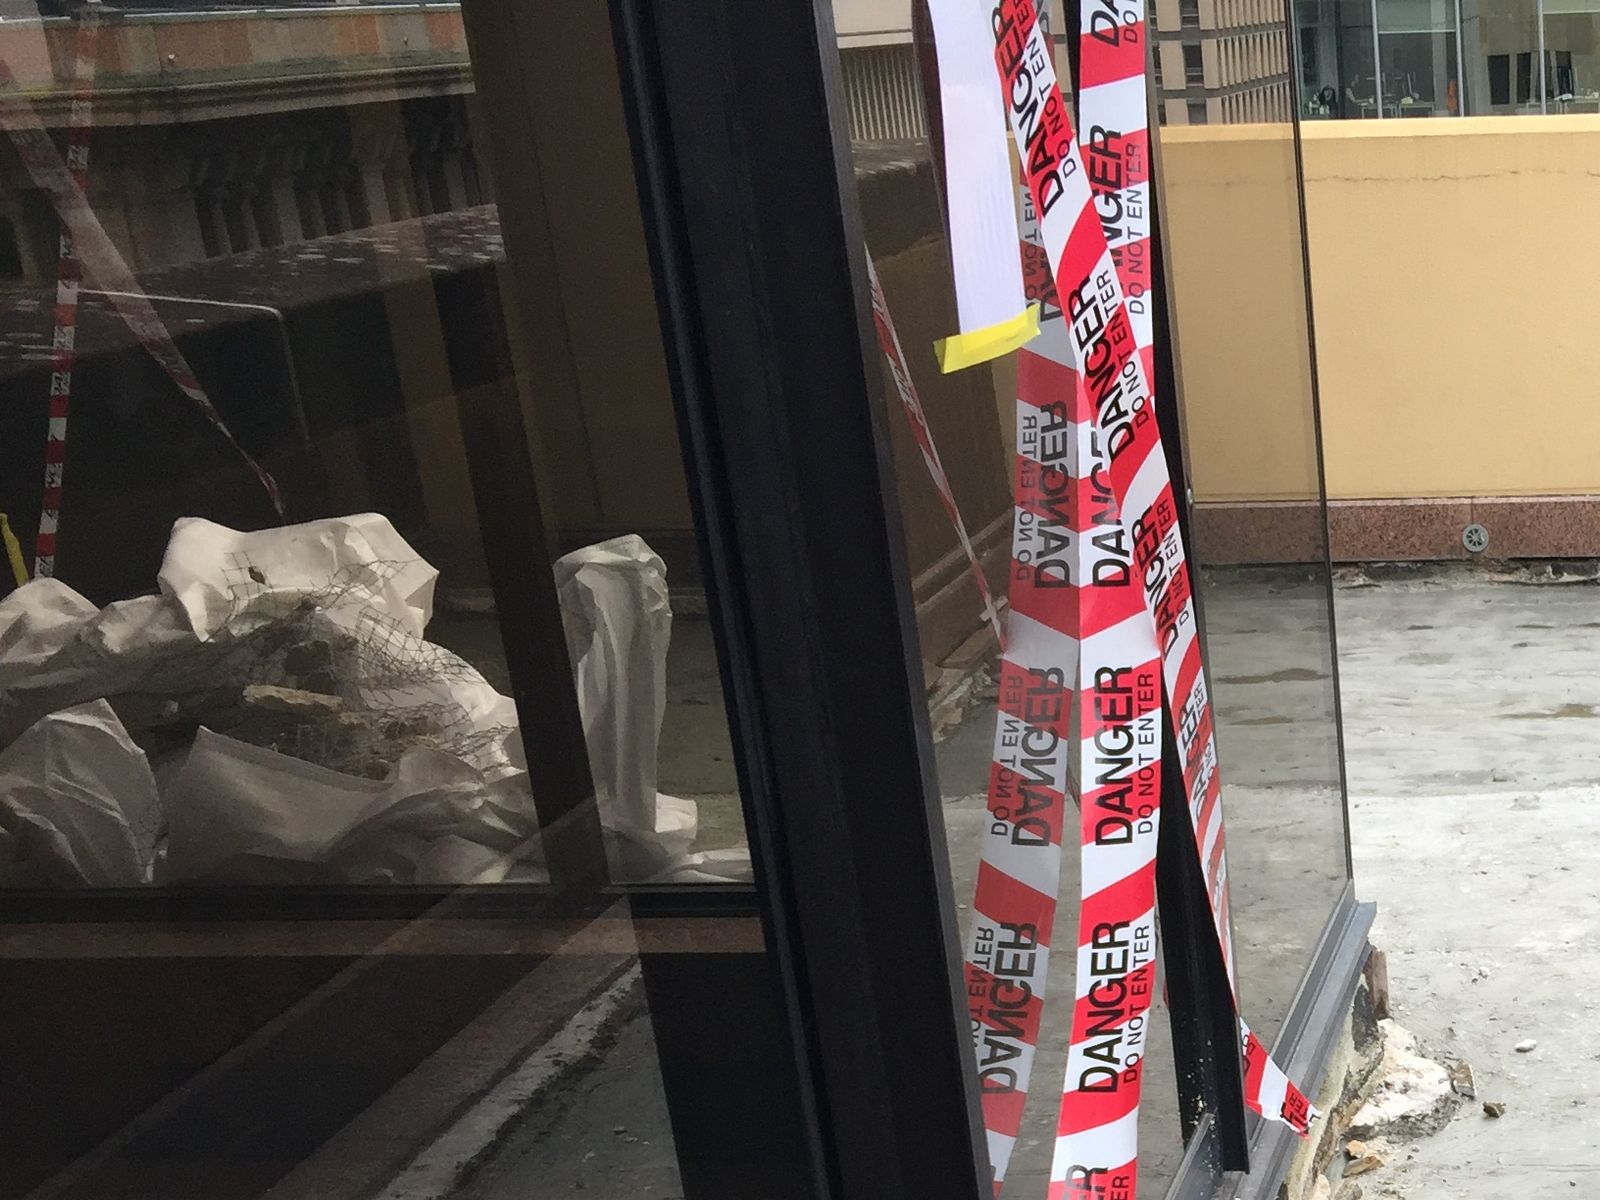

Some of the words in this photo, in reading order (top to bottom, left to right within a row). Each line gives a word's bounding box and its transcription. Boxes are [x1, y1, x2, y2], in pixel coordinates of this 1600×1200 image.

[991, 0, 1064, 218] DANGER
[1038, 83, 1064, 136] NOT
[1057, 139, 1077, 179] DO
[1126, 142, 1142, 219] ENTER
[1127, 227, 1144, 273] NOT
[1096, 270, 1127, 346] ENTER
[1129, 282, 1145, 314] DO
[1068, 276, 1135, 464] DANGER
[1119, 347, 1141, 393] NOT
[1131, 396, 1149, 428] DO
[1156, 499, 1178, 561] ENTER
[1131, 505, 1178, 661] DANGER
[1138, 673, 1154, 746] ENTER
[1094, 666, 1134, 846] DANGER
[1138, 753, 1154, 796] NOT
[1138, 802, 1154, 834] DO
[1131, 924, 1150, 997] ENTER
[1078, 920, 1130, 1093] DANGER
[1128, 1005, 1145, 1047] NOT
[1124, 1052, 1140, 1084] DO
